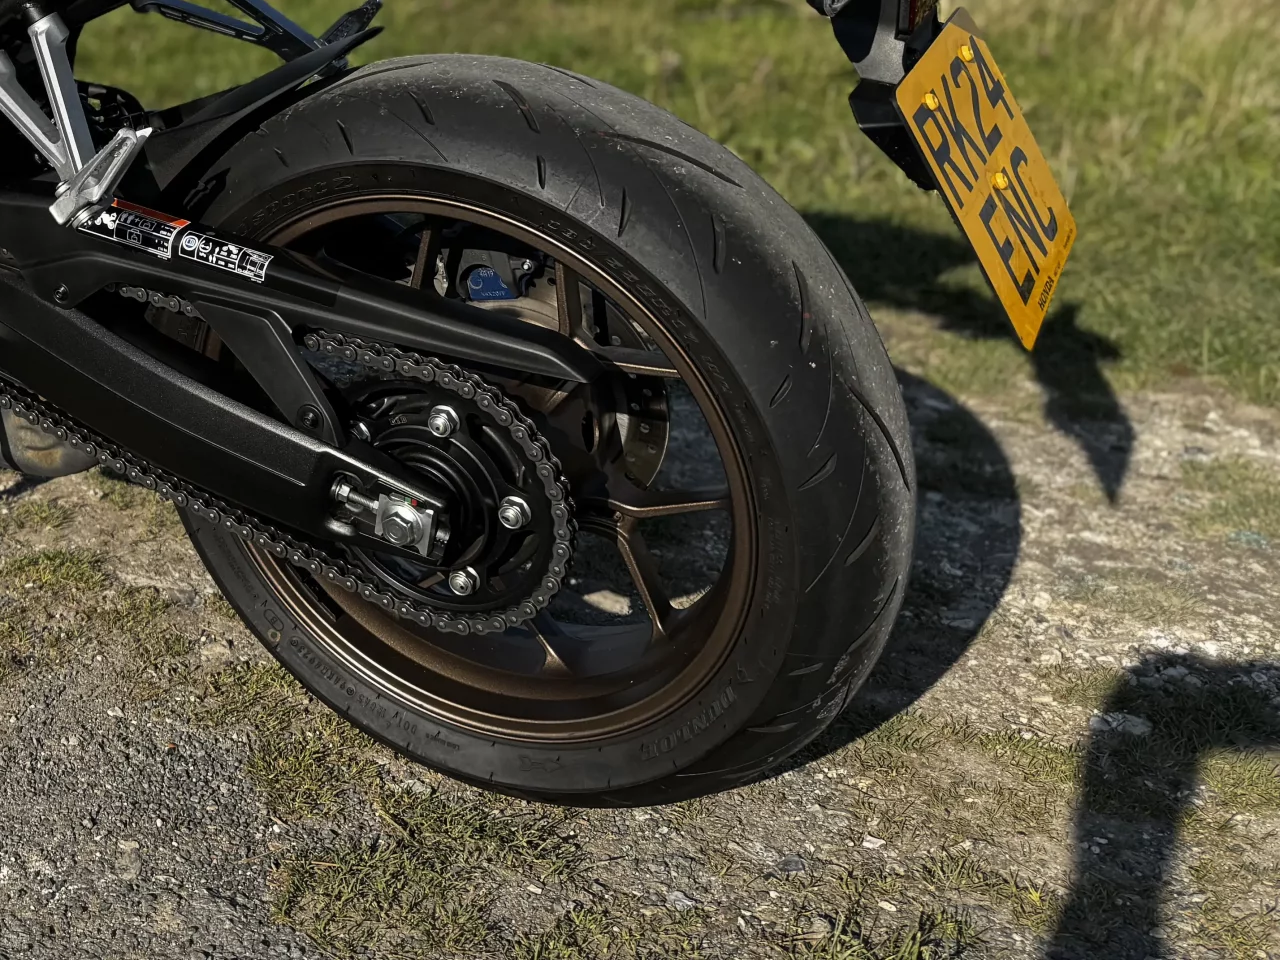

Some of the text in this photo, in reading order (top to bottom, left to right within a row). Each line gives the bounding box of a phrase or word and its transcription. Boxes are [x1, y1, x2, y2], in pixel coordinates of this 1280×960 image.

[912, 35, 1015, 209] RK24
[978, 145, 1057, 307] ENC
[1037, 275, 1055, 312] HONDA
